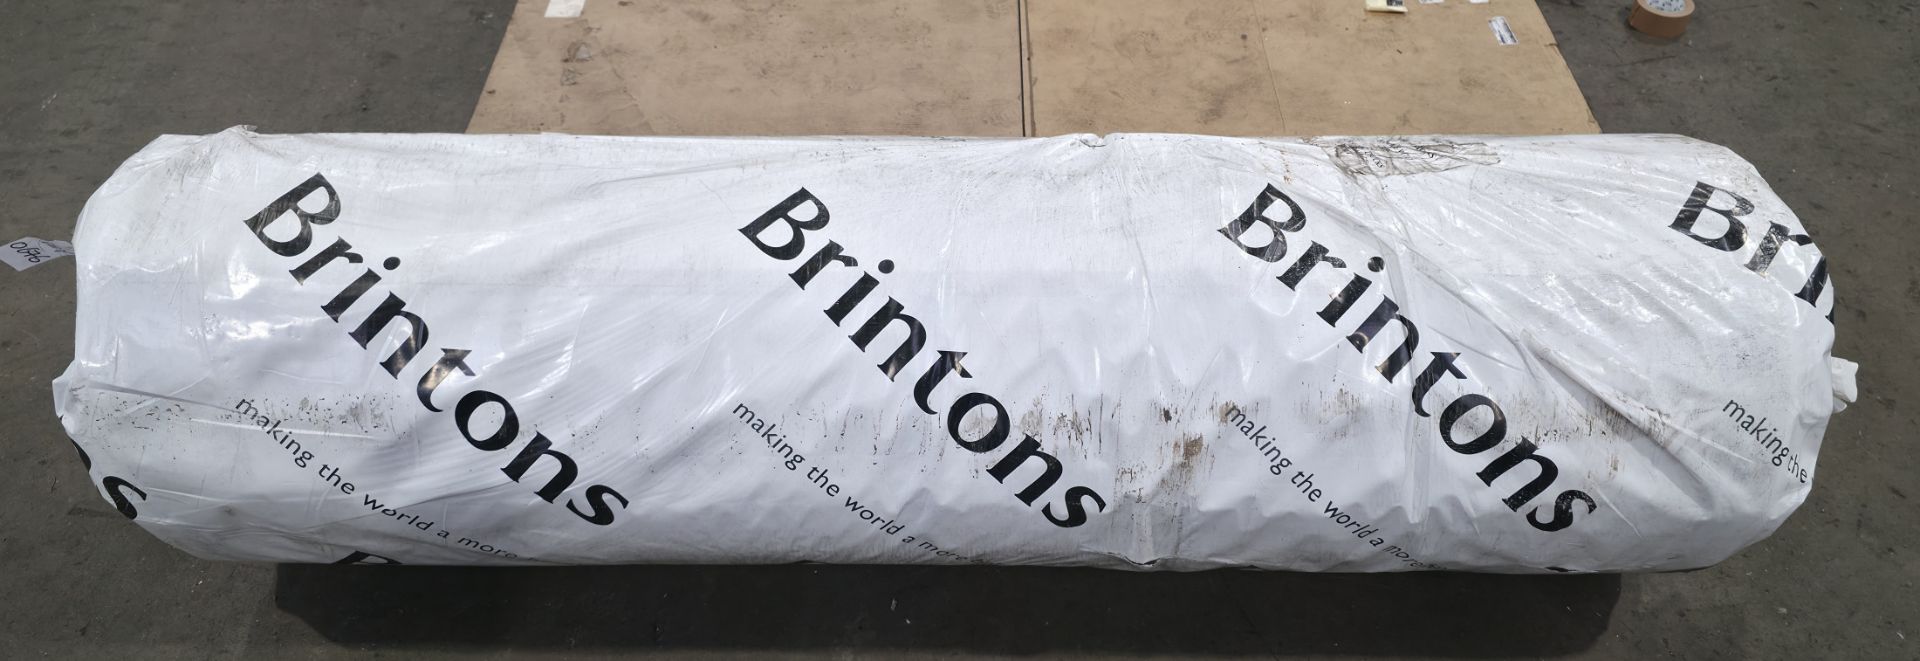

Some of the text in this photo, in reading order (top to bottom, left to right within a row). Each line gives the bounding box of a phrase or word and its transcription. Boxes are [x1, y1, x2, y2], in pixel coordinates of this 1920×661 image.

[243, 173, 629, 526] Brintons
[739, 187, 1106, 529] Brintons
[1217, 182, 1597, 533] Brintons
[235, 398, 518, 559] making the world a more
[733, 403, 806, 471] making
[807, 466, 840, 497] the
[845, 496, 905, 535] world
[902, 535, 915, 544] a
[1225, 405, 1293, 476] making
[1291, 471, 1322, 502] the
[1324, 500, 1379, 539] world
[1369, 536, 1384, 547] a
[1722, 399, 1808, 484] making the
